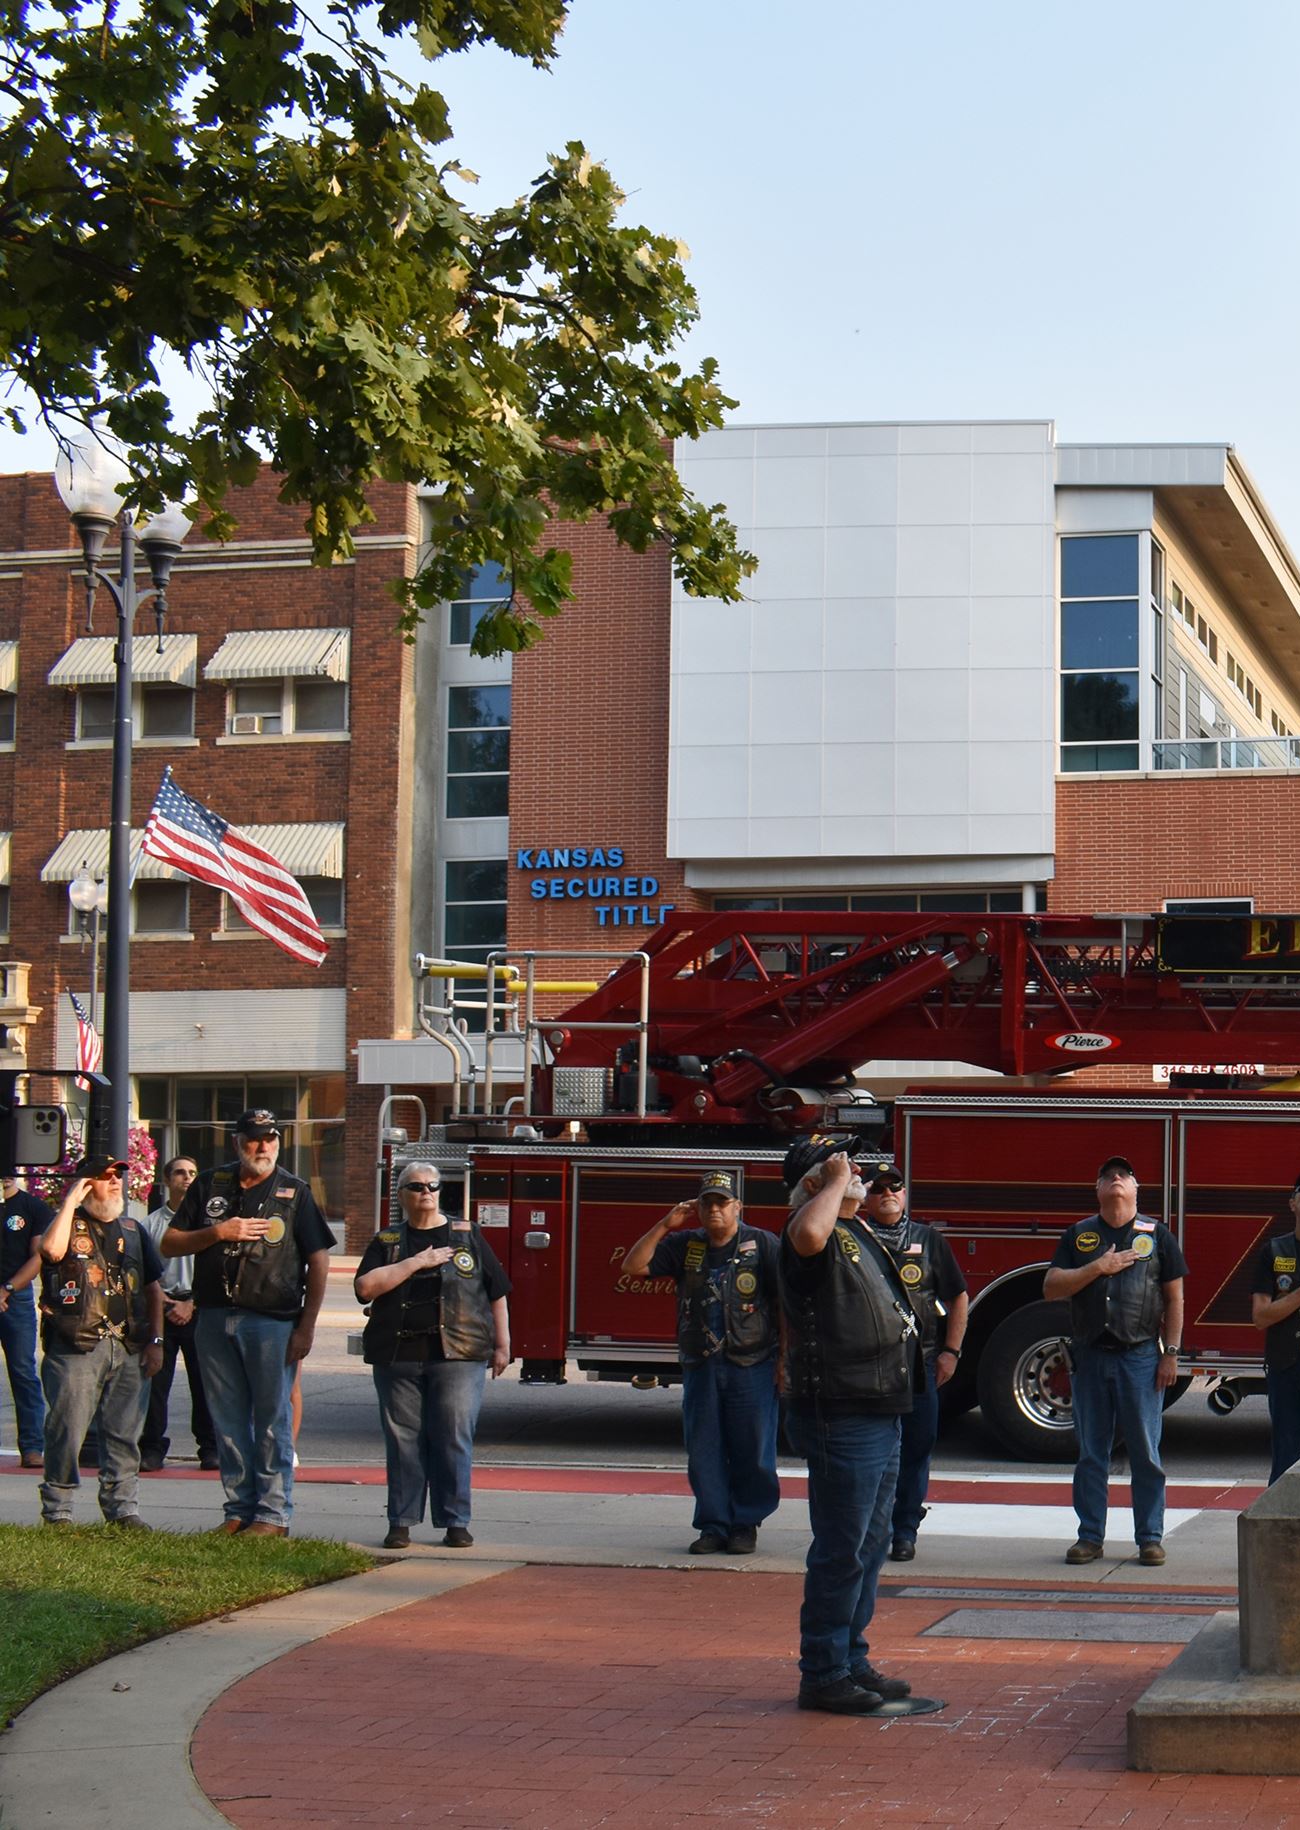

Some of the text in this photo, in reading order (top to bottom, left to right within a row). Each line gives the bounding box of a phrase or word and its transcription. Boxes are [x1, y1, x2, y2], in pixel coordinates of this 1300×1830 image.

[516, 847, 625, 869] KANSAS
[530, 876, 660, 899] SECURED
[1061, 1034, 1105, 1048] Pierce
